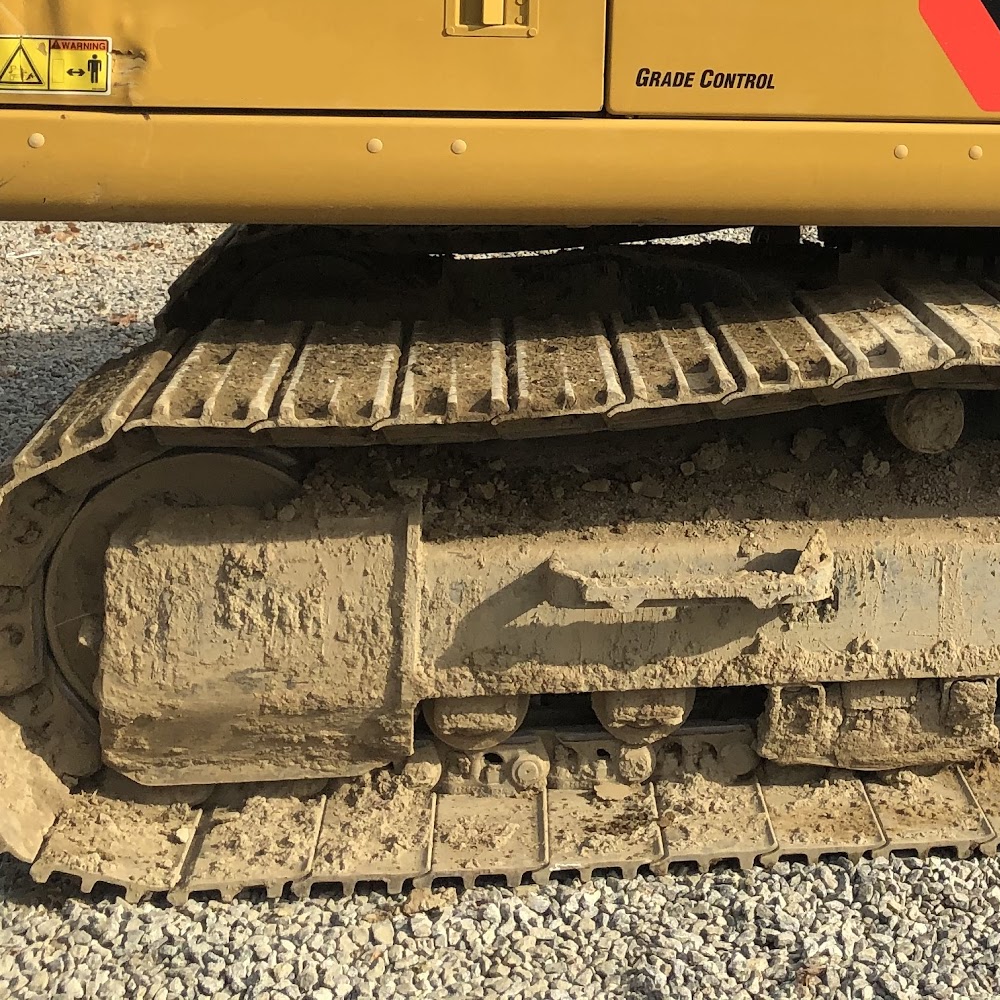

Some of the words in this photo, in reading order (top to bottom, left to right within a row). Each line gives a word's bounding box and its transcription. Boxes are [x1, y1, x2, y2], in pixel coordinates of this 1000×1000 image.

[61, 41, 106, 50] WARNING
[635, 67, 695, 88] GRADE
[700, 69, 775, 89] CONTROL
